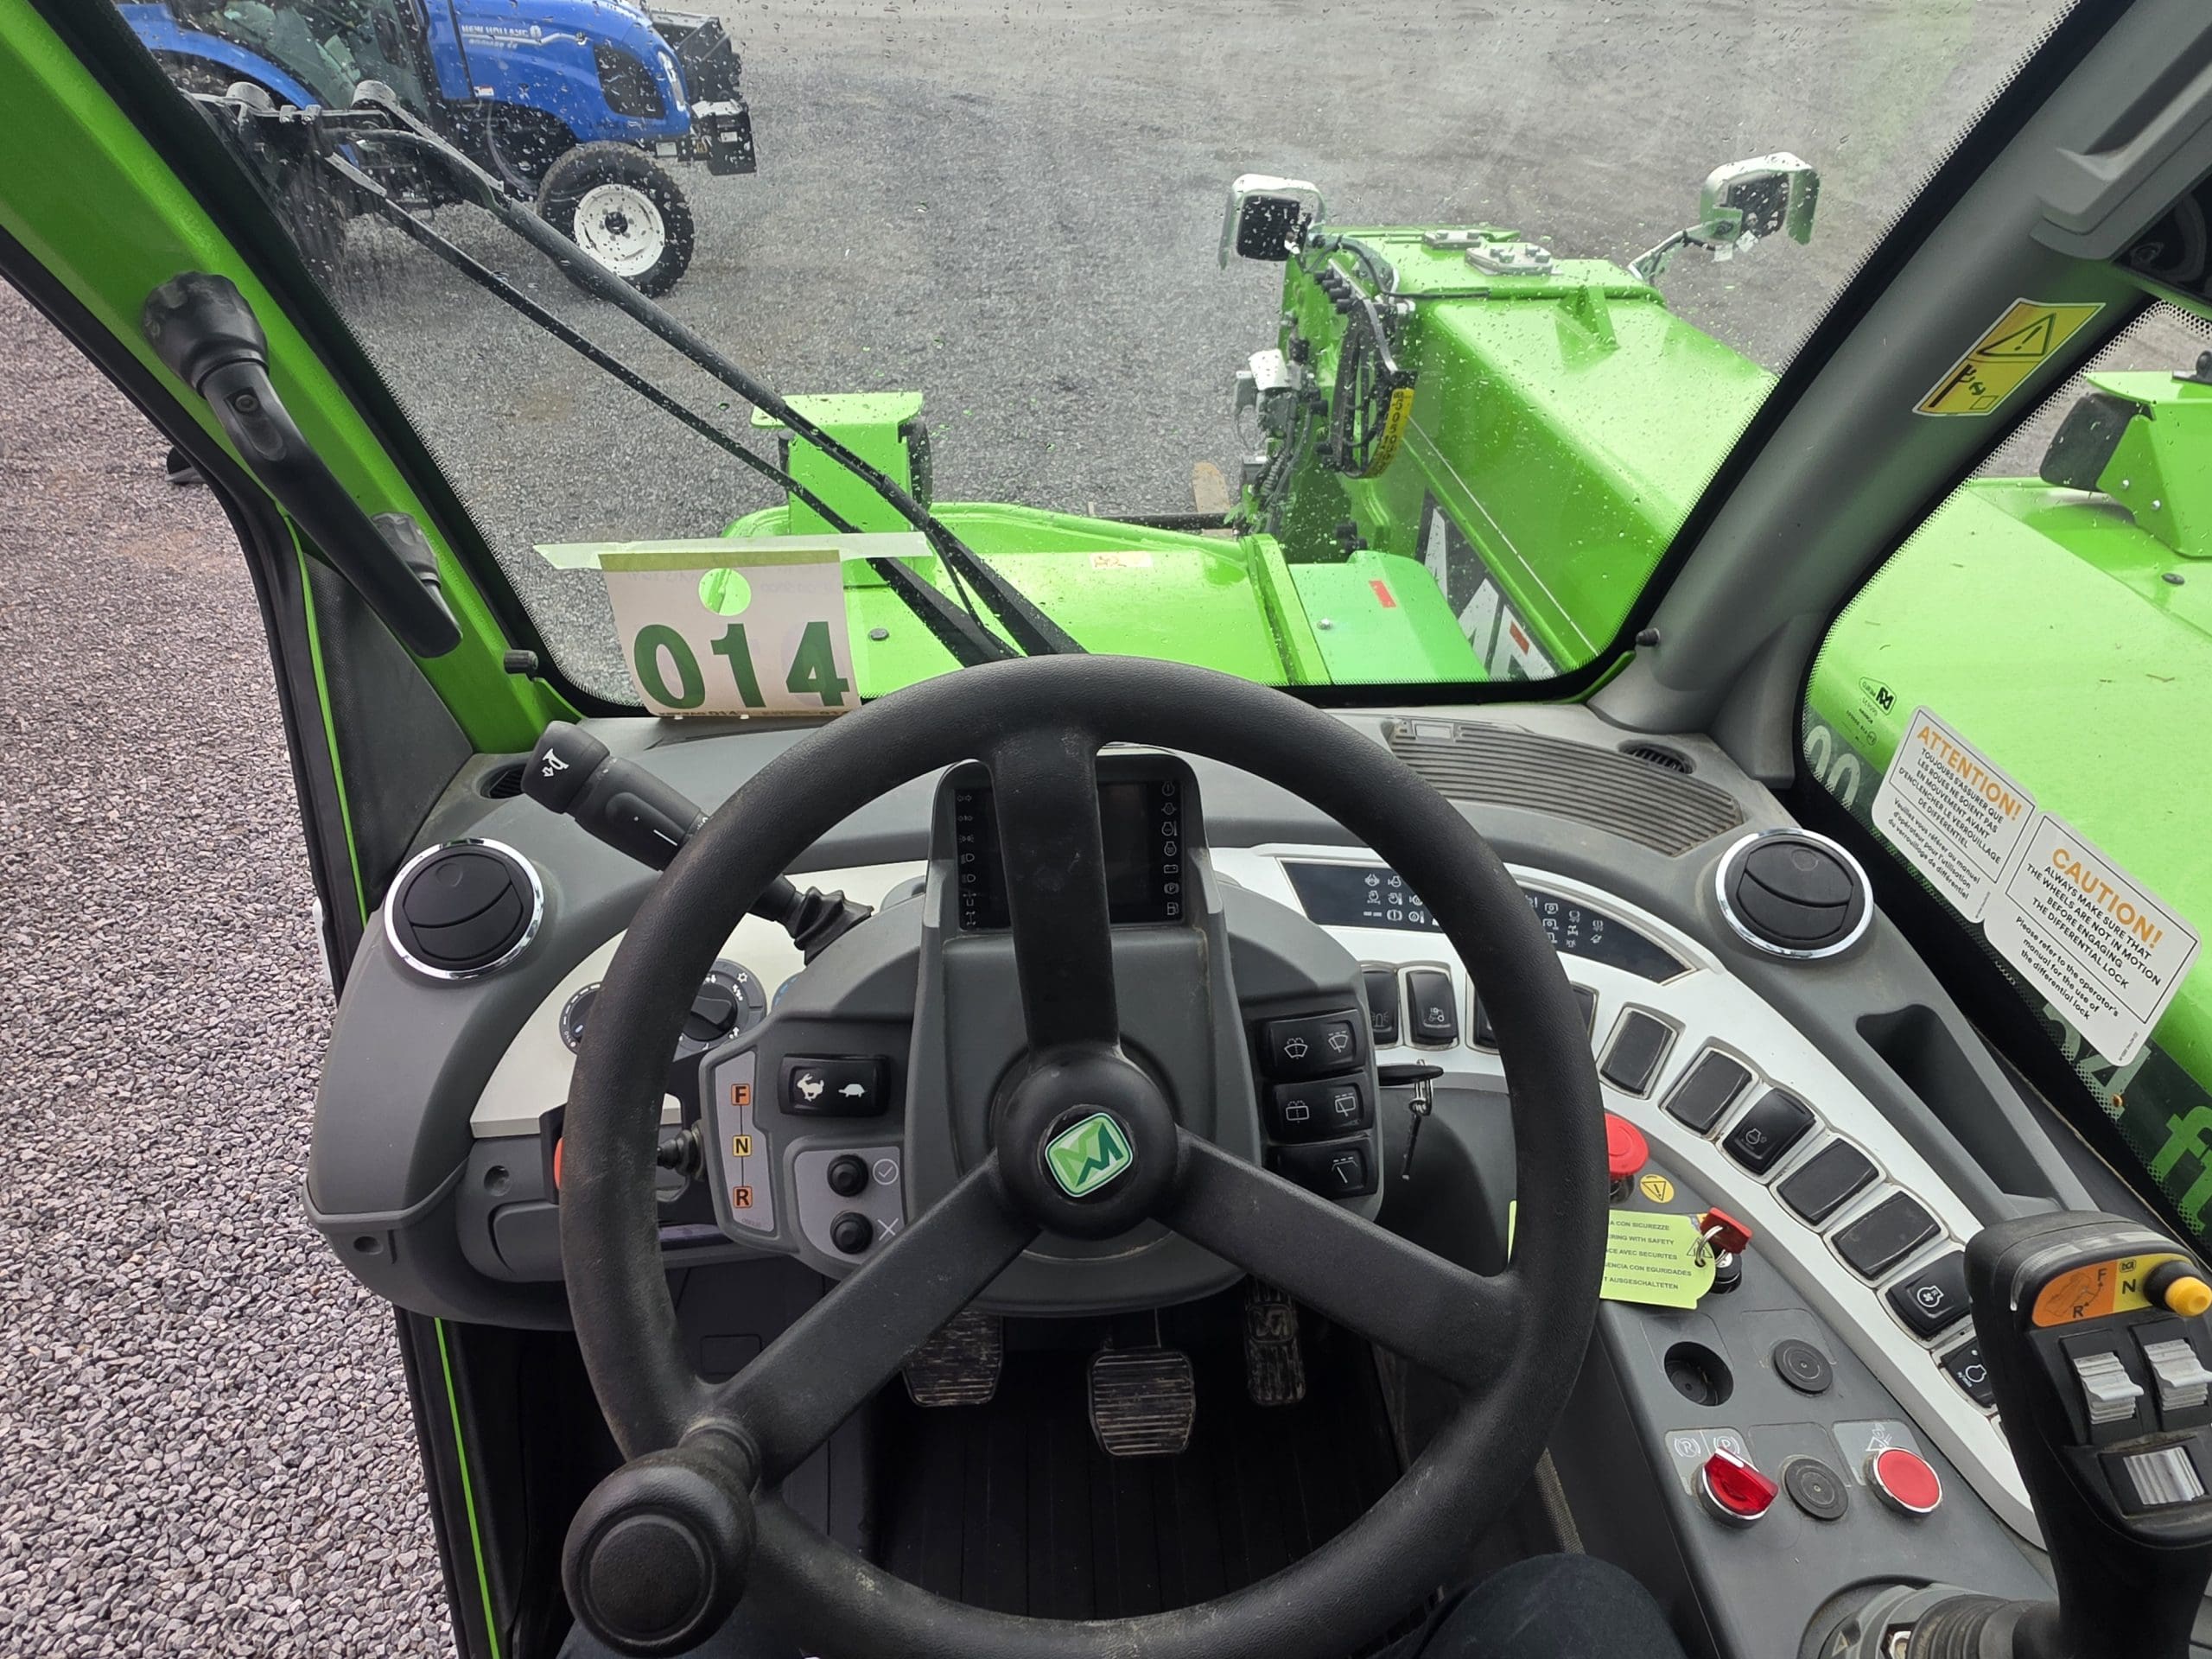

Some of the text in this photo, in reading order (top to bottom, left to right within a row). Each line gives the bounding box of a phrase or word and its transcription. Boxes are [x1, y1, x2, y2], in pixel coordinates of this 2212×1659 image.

[461, 24, 484, 34] NEW
[633, 620, 850, 709] 014
[1916, 725, 2022, 821] ATTENTION!
[1916, 758, 1999, 834] LES ROUES NE SOIENT PAS
[1916, 769, 1991, 839] EN MOUVEMENT AVANT
[1921, 747, 2004, 824] TOUJOURS S'ASSURER QUE
[1893, 810, 1971, 889] d'opérateur pour l'utilisation
[1894, 797, 1981, 884] Veuillez vous référer au manuel
[1898, 766, 2001, 865] D'ENCLENCHER LE VERROUILLAGE
[1917, 797, 1968, 849] DE DIFFÉRENTIEL
[1887, 818, 1969, 899] du verrouillage de différentiel
[2026, 862, 2161, 986] THE WHEELS ARE NOT IN MOTION
[2044, 866, 2152, 960] ALWAYS MAKE SURE THAT
[2046, 896, 2123, 969] BEFORE ENGAGING
[2052, 848, 2163, 949] CAUTION!
[2015, 915, 2119, 1017] Please refer to the operator's
[2023, 938, 2100, 1013] manual for the use of
[2032, 897, 2130, 989] THE DIFFERENTIAL LOCK
[2020, 949, 2090, 1020] the differential lock
[734, 1086, 747, 1103] F
[735, 1138, 748, 1154] N
[736, 1189, 749, 1205] R
[1609, 1276, 1679, 1289] AUSGESCHALTETEN
[1639, 1251, 1678, 1260] SECURITES
[1646, 1266, 1692, 1276] EGURIDADES
[2097, 1268, 2107, 1281] F
[2122, 1279, 2137, 1294] N
[2073, 1306, 2084, 1319] R
